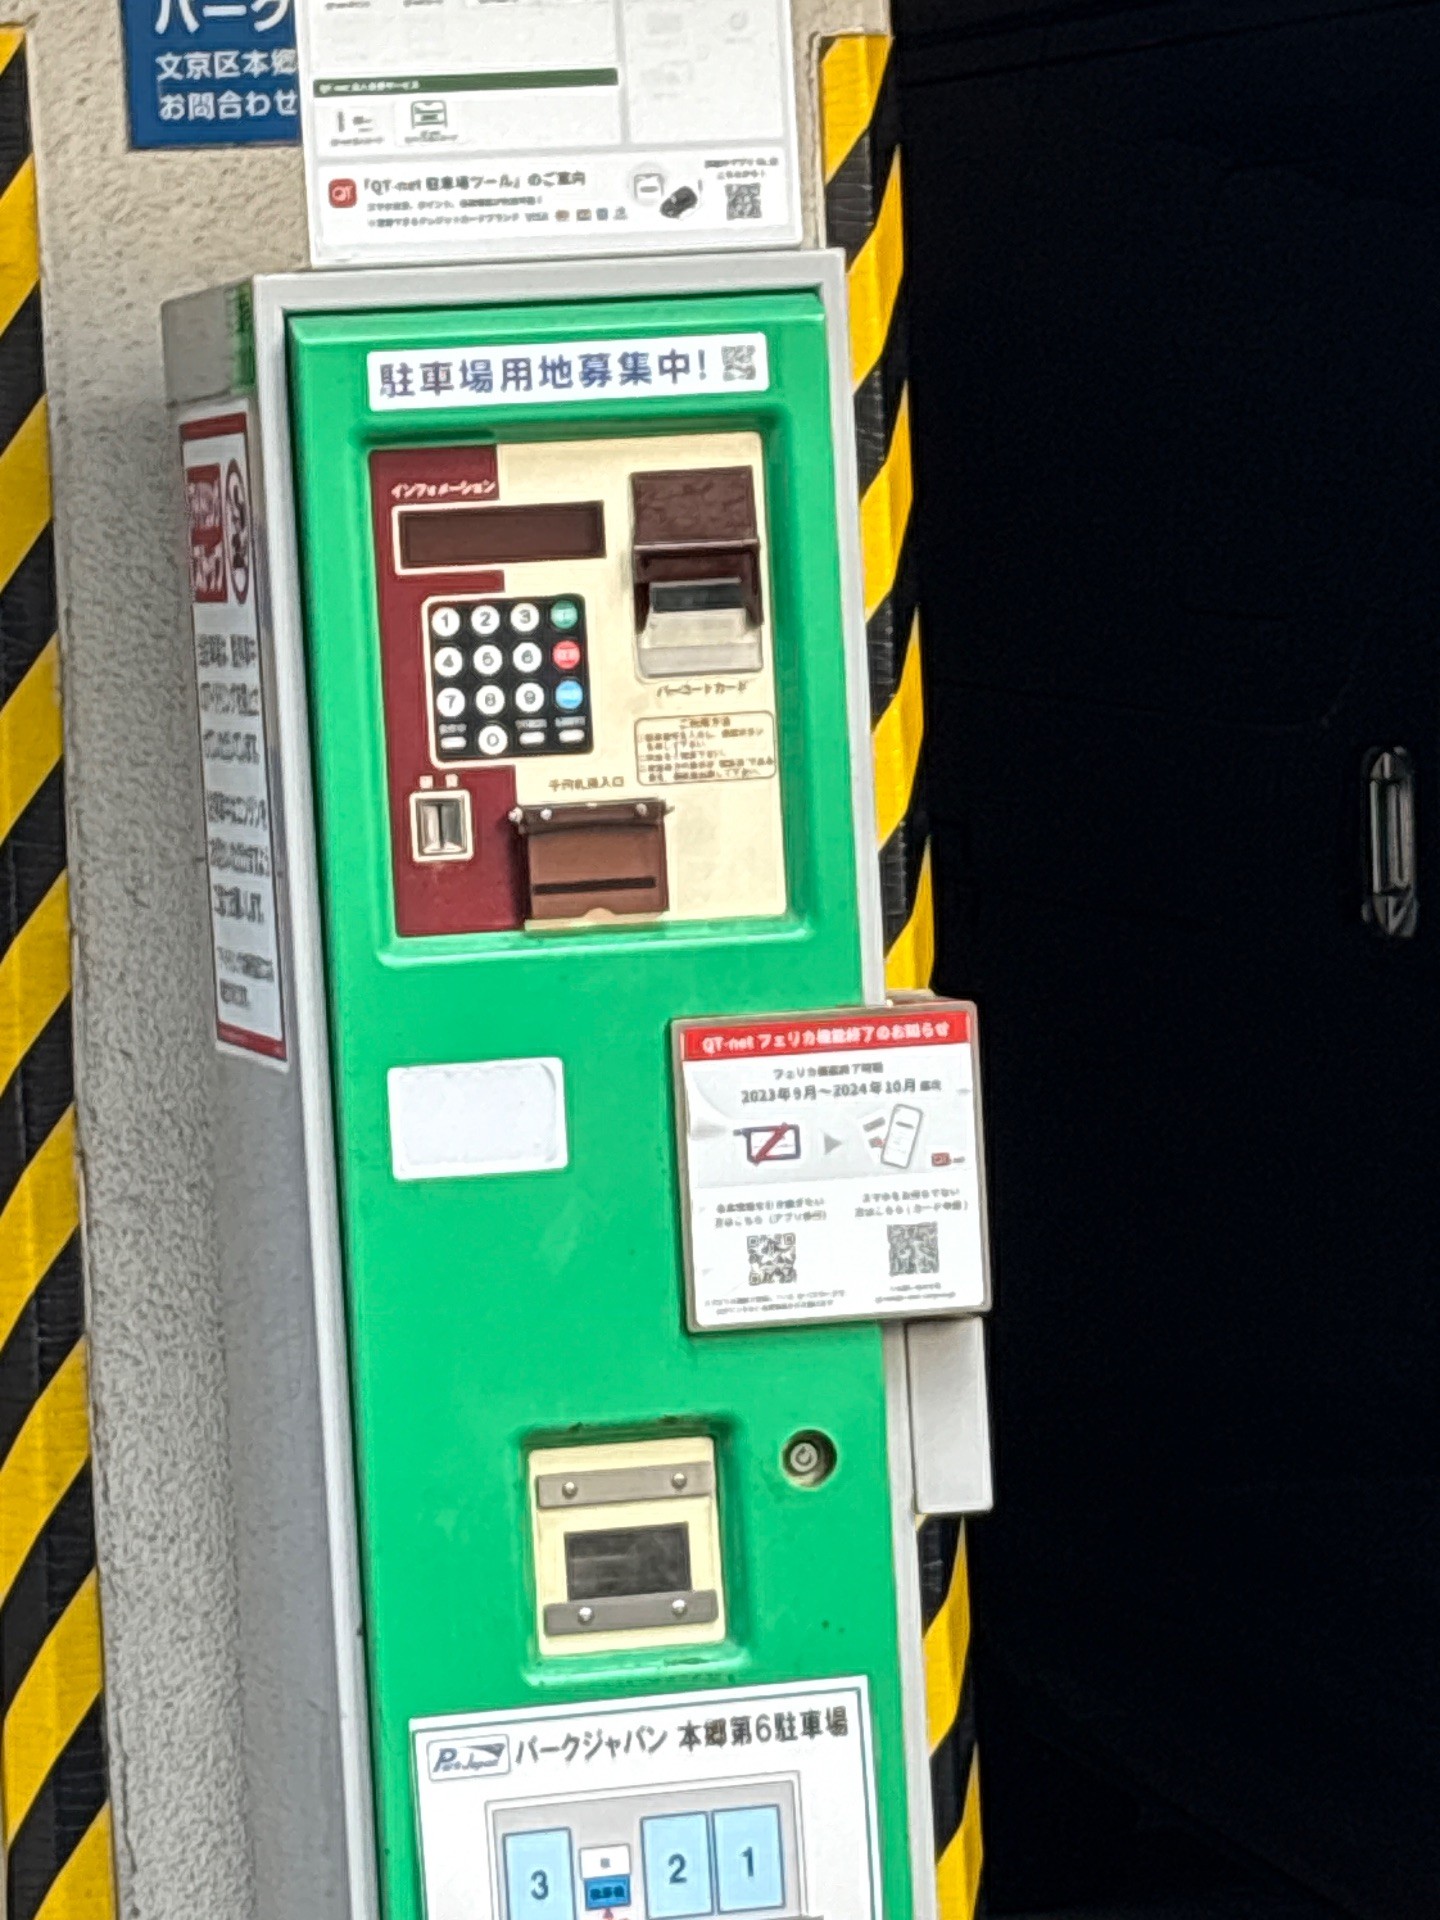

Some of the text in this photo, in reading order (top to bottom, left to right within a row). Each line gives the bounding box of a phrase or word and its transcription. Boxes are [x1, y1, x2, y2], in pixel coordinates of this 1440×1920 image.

[158, 90, 298, 121] お問合わせ
[379, 349, 706, 398] 駐車場用地募集中!
[441, 609, 531, 629] 1 2 3
[443, 650, 532, 669] 4 5 6
[446, 695, 456, 709] 7
[487, 733, 499, 747] 0
[677, 1705, 849, 1748] 本郷第6駐車場
[668, 1853, 688, 1884] 2
[741, 1846, 755, 1877] 1
[530, 1870, 549, 1900] 3
